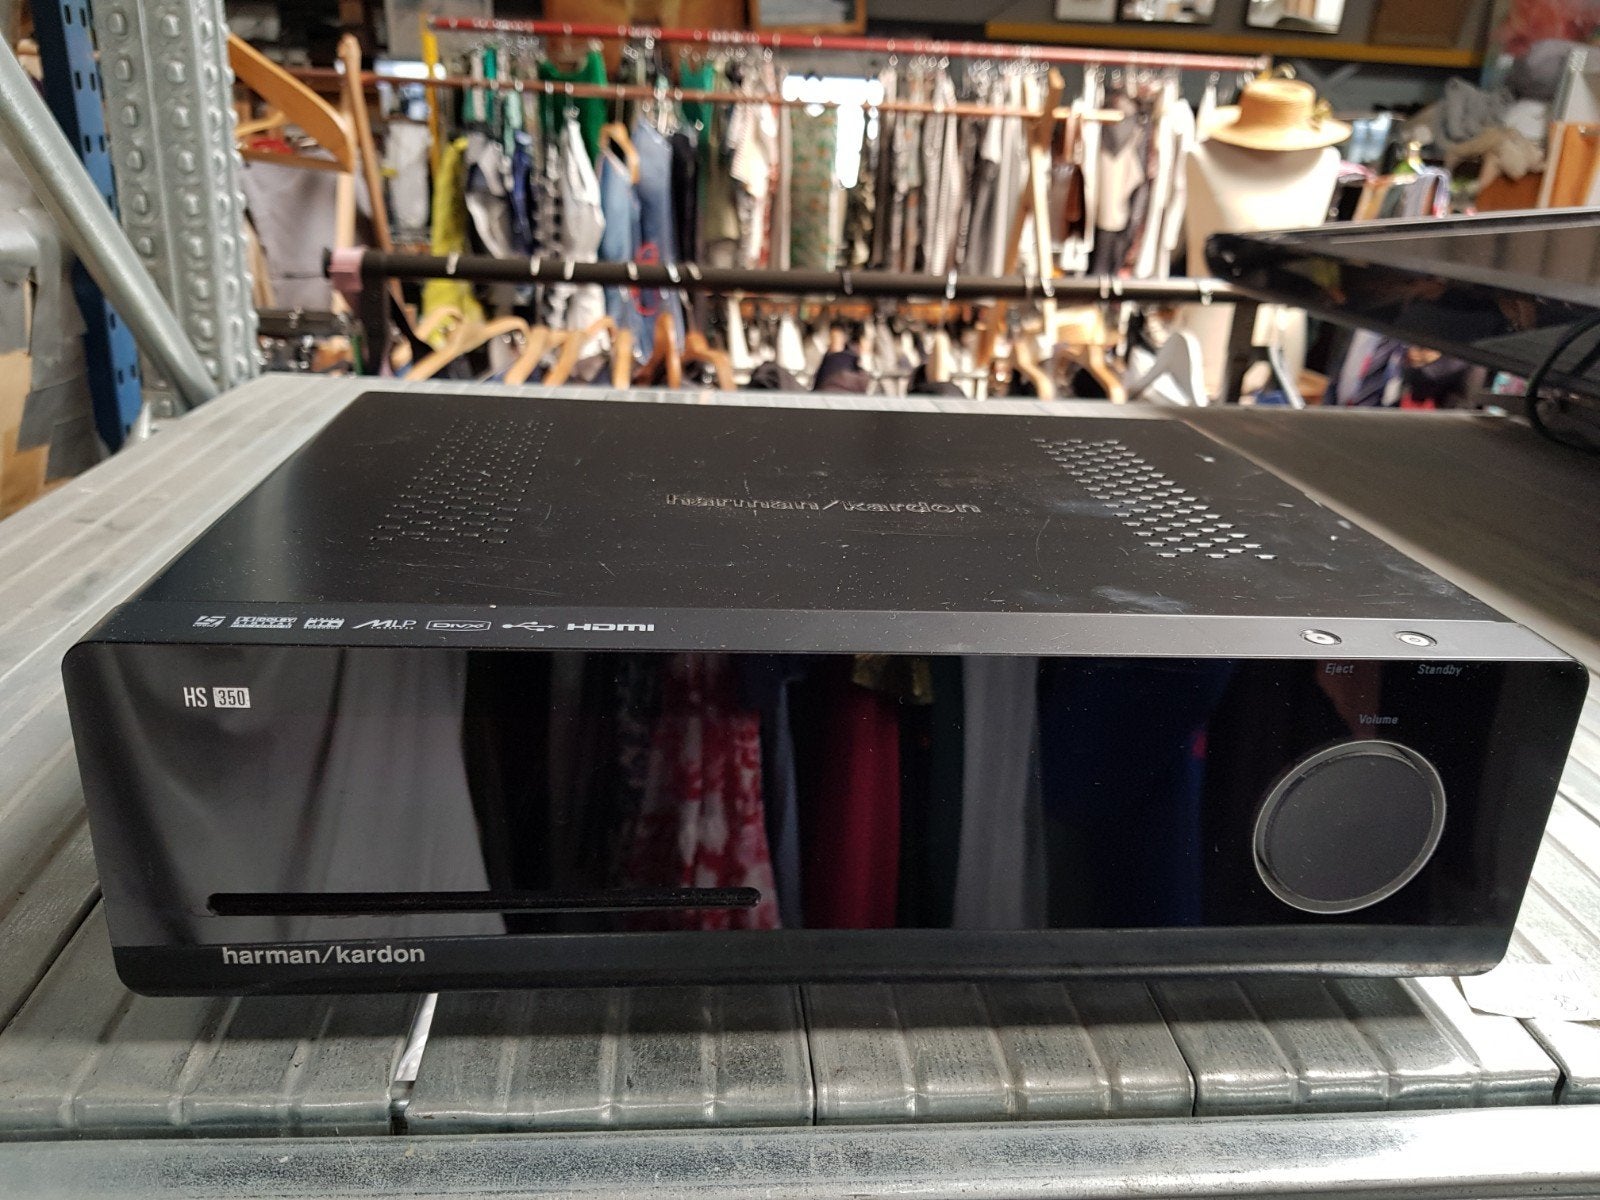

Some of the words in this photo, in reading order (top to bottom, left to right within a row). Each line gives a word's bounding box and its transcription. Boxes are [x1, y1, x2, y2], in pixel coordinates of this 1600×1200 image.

[567, 623, 654, 631] HDMI
[1325, 663, 1354, 675] Eject
[1418, 664, 1462, 676] Standby
[183, 687, 207, 707] HS
[215, 688, 249, 707] 350
[1359, 714, 1398, 724] Volume
[222, 945, 426, 964] harman/kardon
